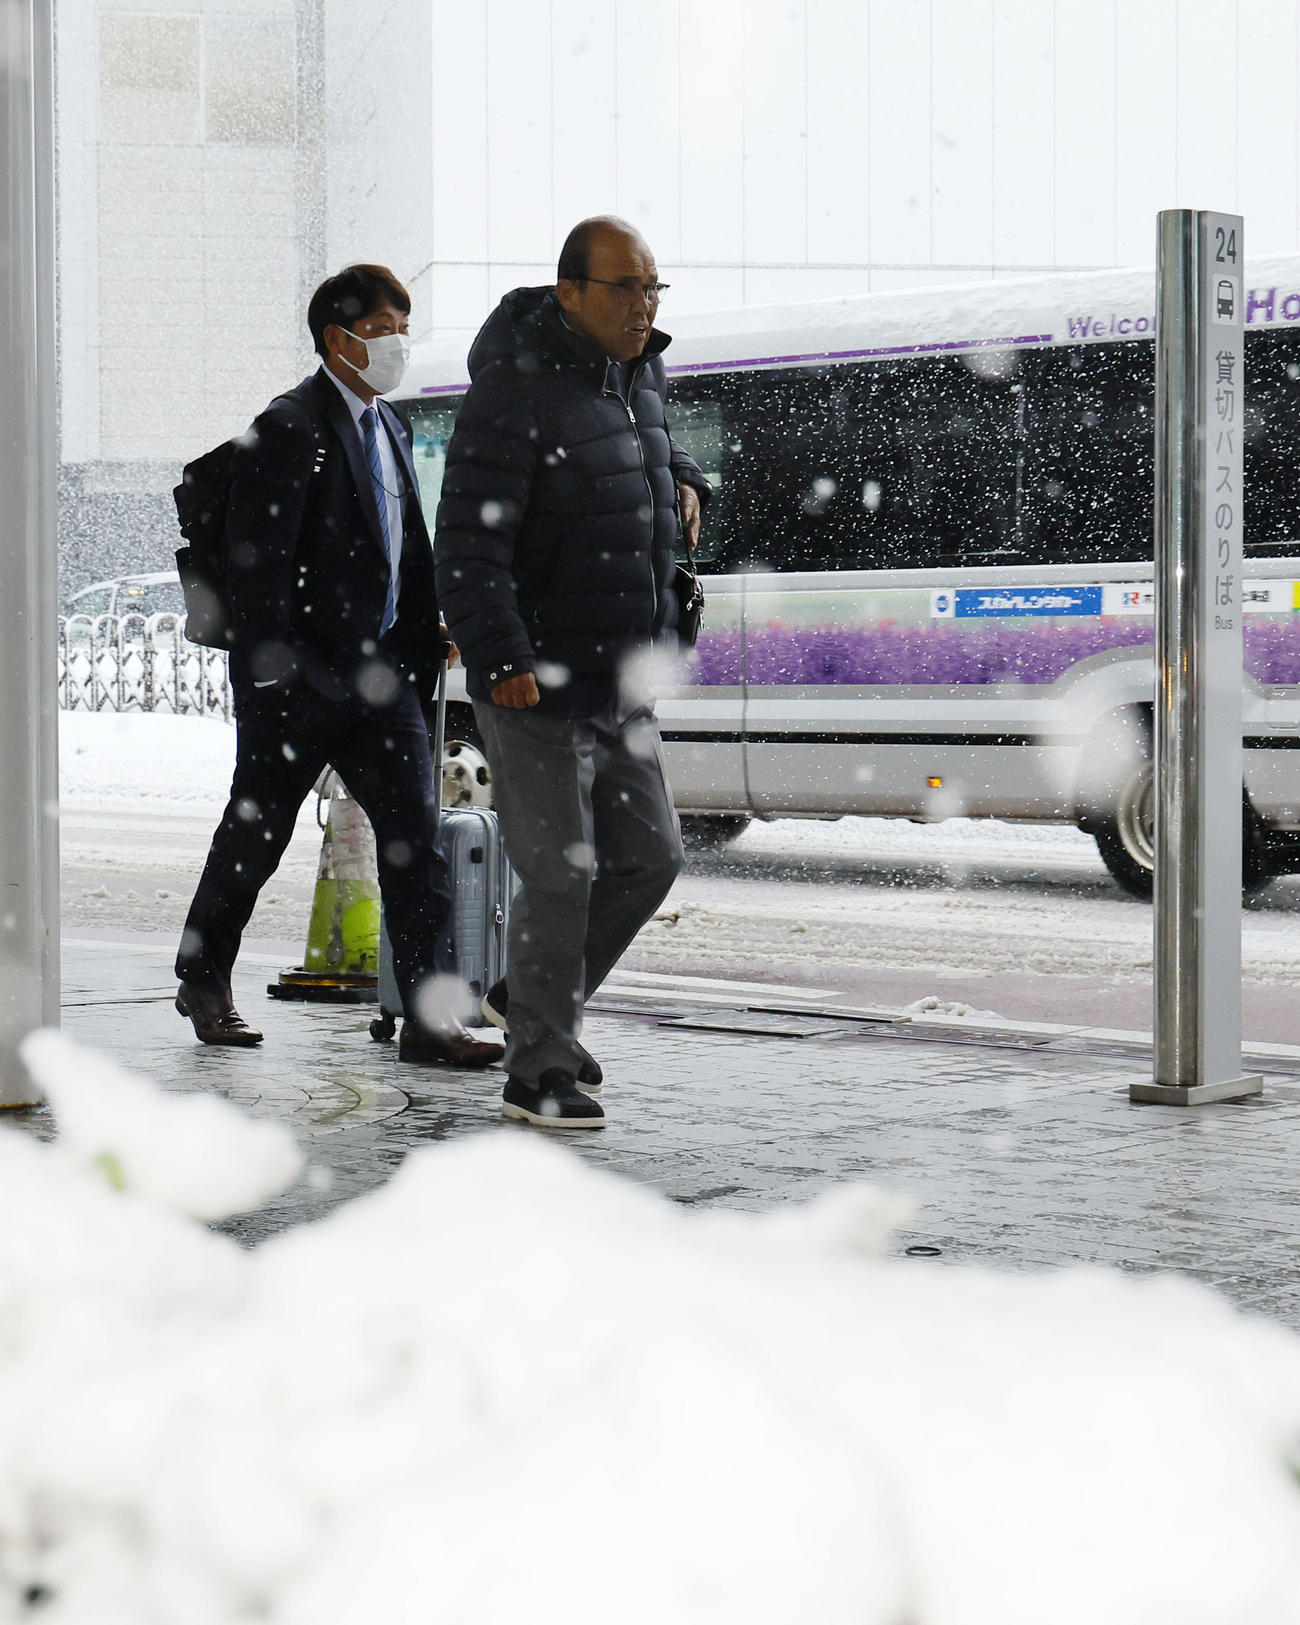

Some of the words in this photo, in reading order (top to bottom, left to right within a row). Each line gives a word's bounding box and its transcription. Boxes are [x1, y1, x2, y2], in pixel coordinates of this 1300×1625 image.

[1215, 226, 1236, 264] 24
[1067, 314, 1156, 339] Welco
[1215, 350, 1235, 606] 貸切バスのりば
[1215, 615, 1233, 630] Bus
